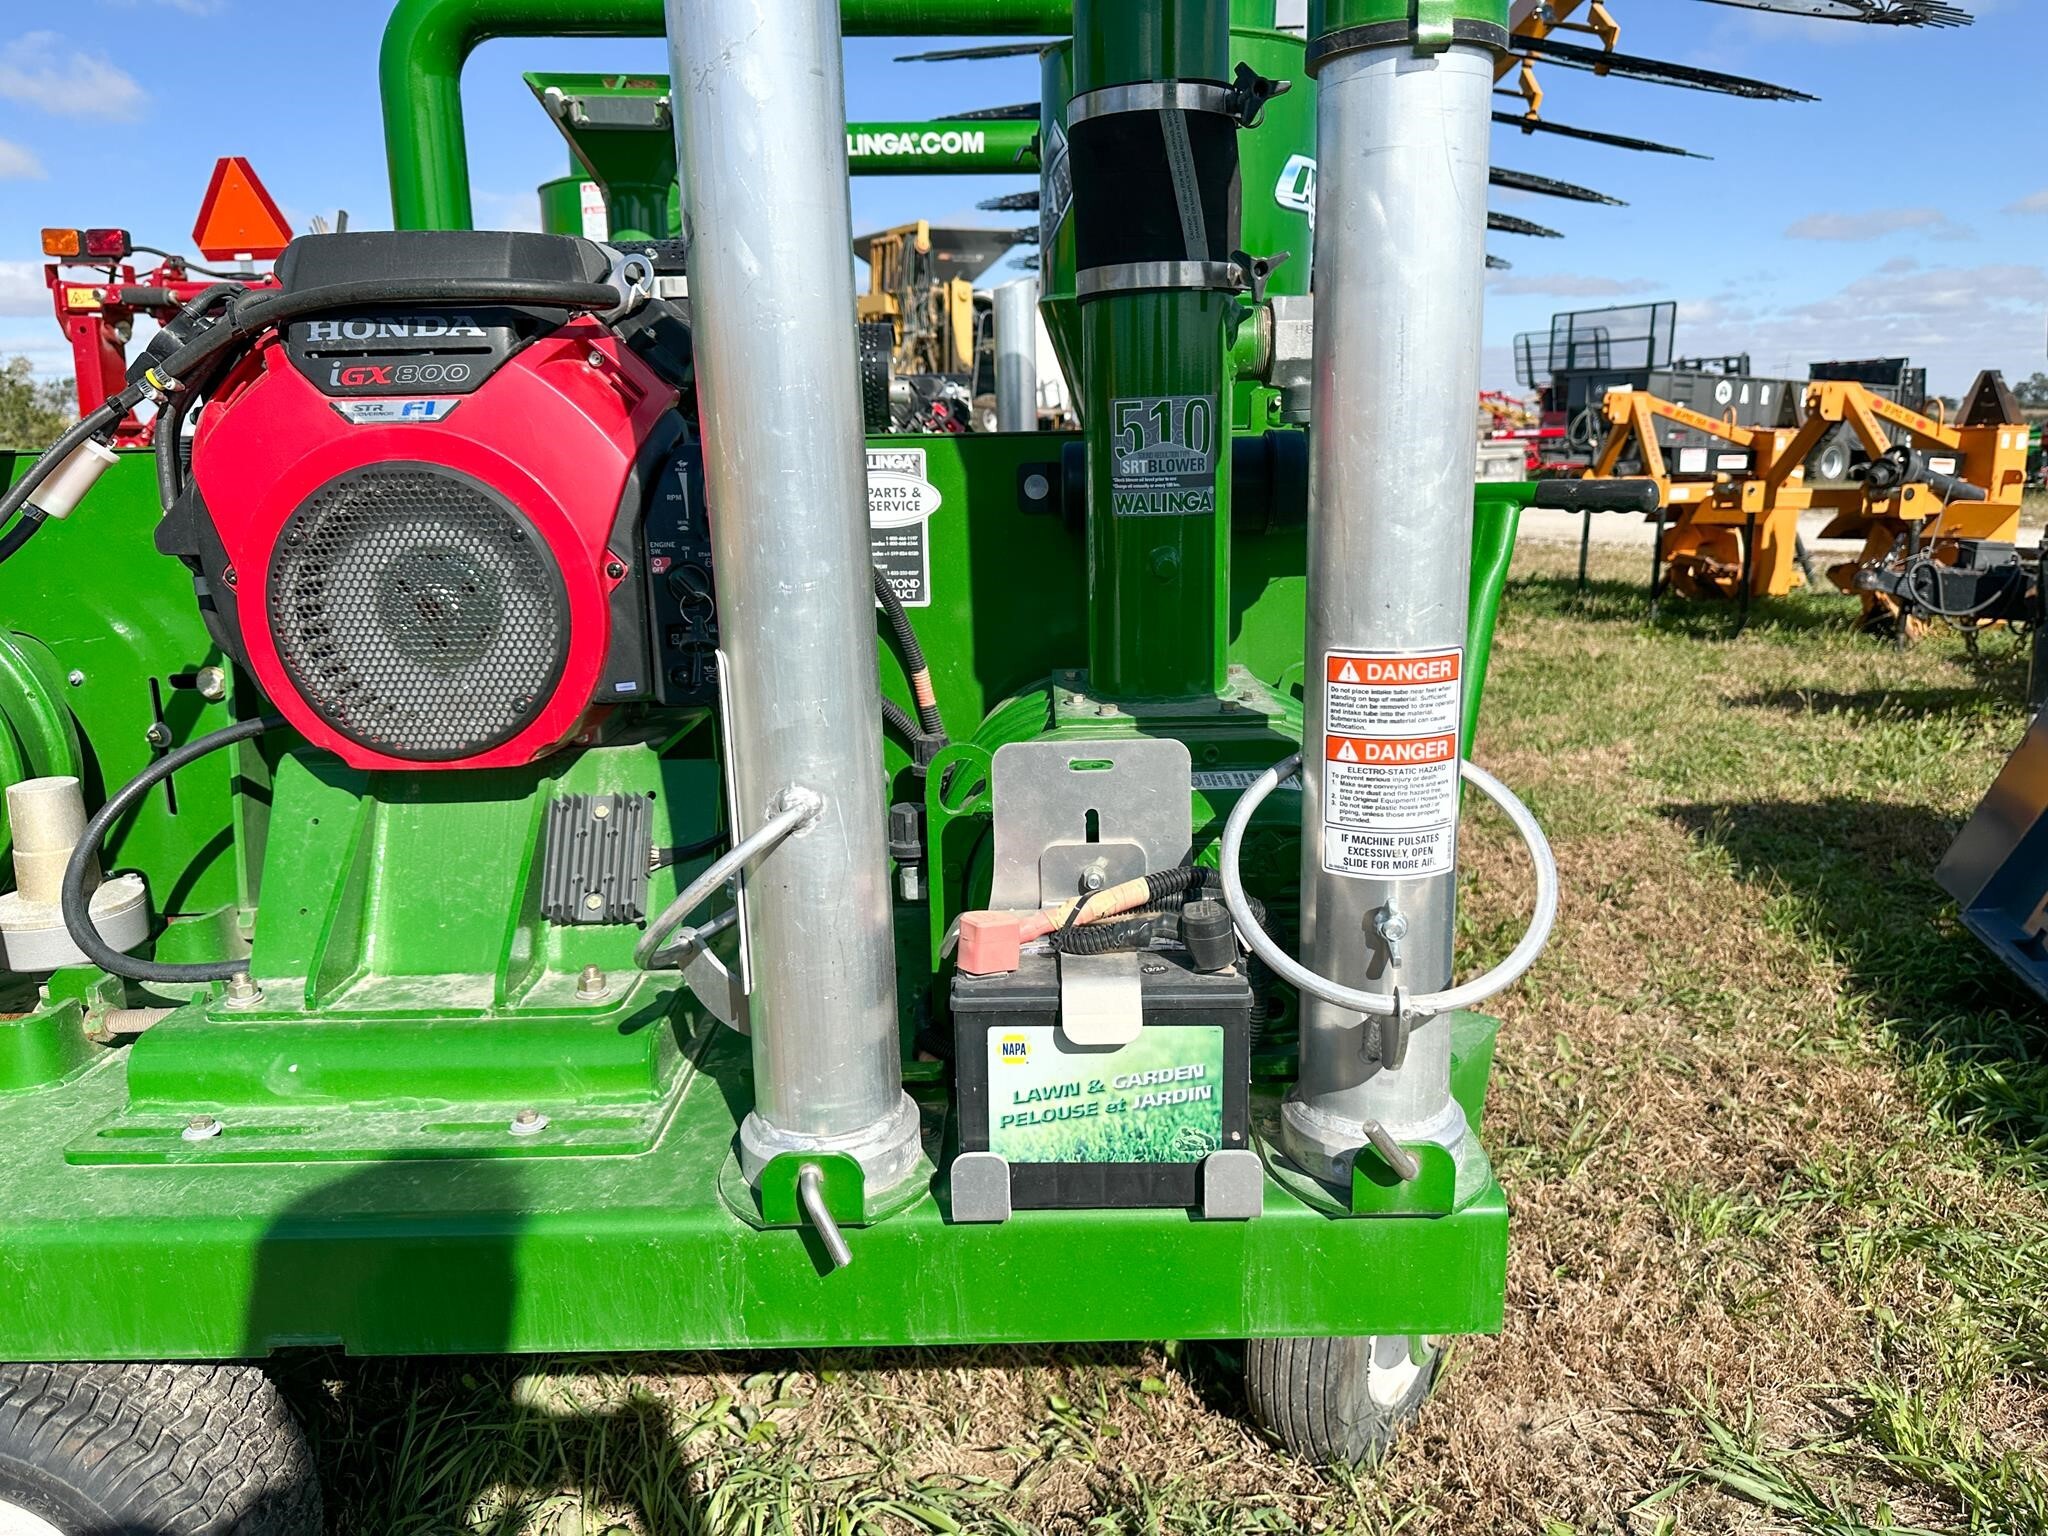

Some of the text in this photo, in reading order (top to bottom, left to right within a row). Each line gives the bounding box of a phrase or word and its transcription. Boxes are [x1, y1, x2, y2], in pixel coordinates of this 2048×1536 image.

[307, 315, 487, 342] HONDA
[1115, 398, 1211, 460] 510
[912, 488, 921, 497] &
[869, 501, 920, 511] SERVICE
[1367, 660, 1451, 680] DANGER
[1330, 694, 1356, 702] standing
[1330, 715, 1367, 723] Submersion
[1330, 722, 1366, 730] suffocation.
[1365, 740, 1448, 761] DANGER
[1348, 765, 1446, 775] ELECTRO-STATIC HAZARD
[1339, 815, 1371, 824] grounded.
[1341, 833, 1440, 846] IF MACHINE PULSATES
[1412, 846, 1433, 856] OPEN
[1343, 857, 1368, 868] SLIDE
[1371, 860, 1389, 870] FOR
[1392, 859, 1418, 870] MORE
[1002, 1042, 1026, 1056] NAPA
[1013, 1063, 1206, 1105] LAWN & GARDEN
[1000, 1084, 1213, 1128] PELOUSE et JARDIN
